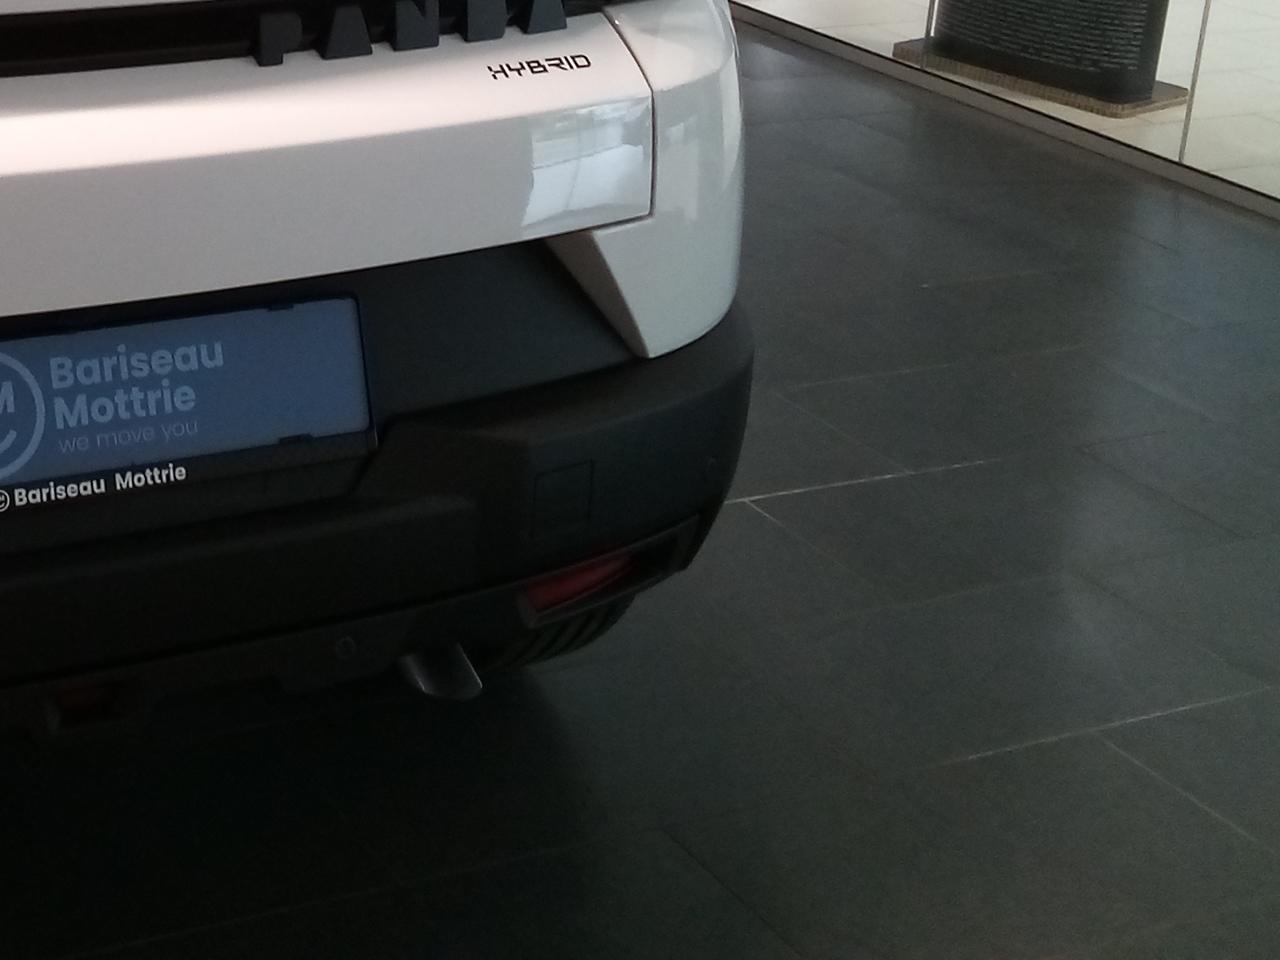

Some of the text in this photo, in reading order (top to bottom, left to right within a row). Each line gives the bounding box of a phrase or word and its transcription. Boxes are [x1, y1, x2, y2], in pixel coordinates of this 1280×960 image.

[487, 54, 592, 80] HYBRID
[49, 338, 224, 389] Bariseau
[53, 378, 196, 429] Mottrie
[57, 419, 200, 454] we move you
[14, 480, 106, 507] Bariseau
[115, 462, 187, 490] Mottrie
